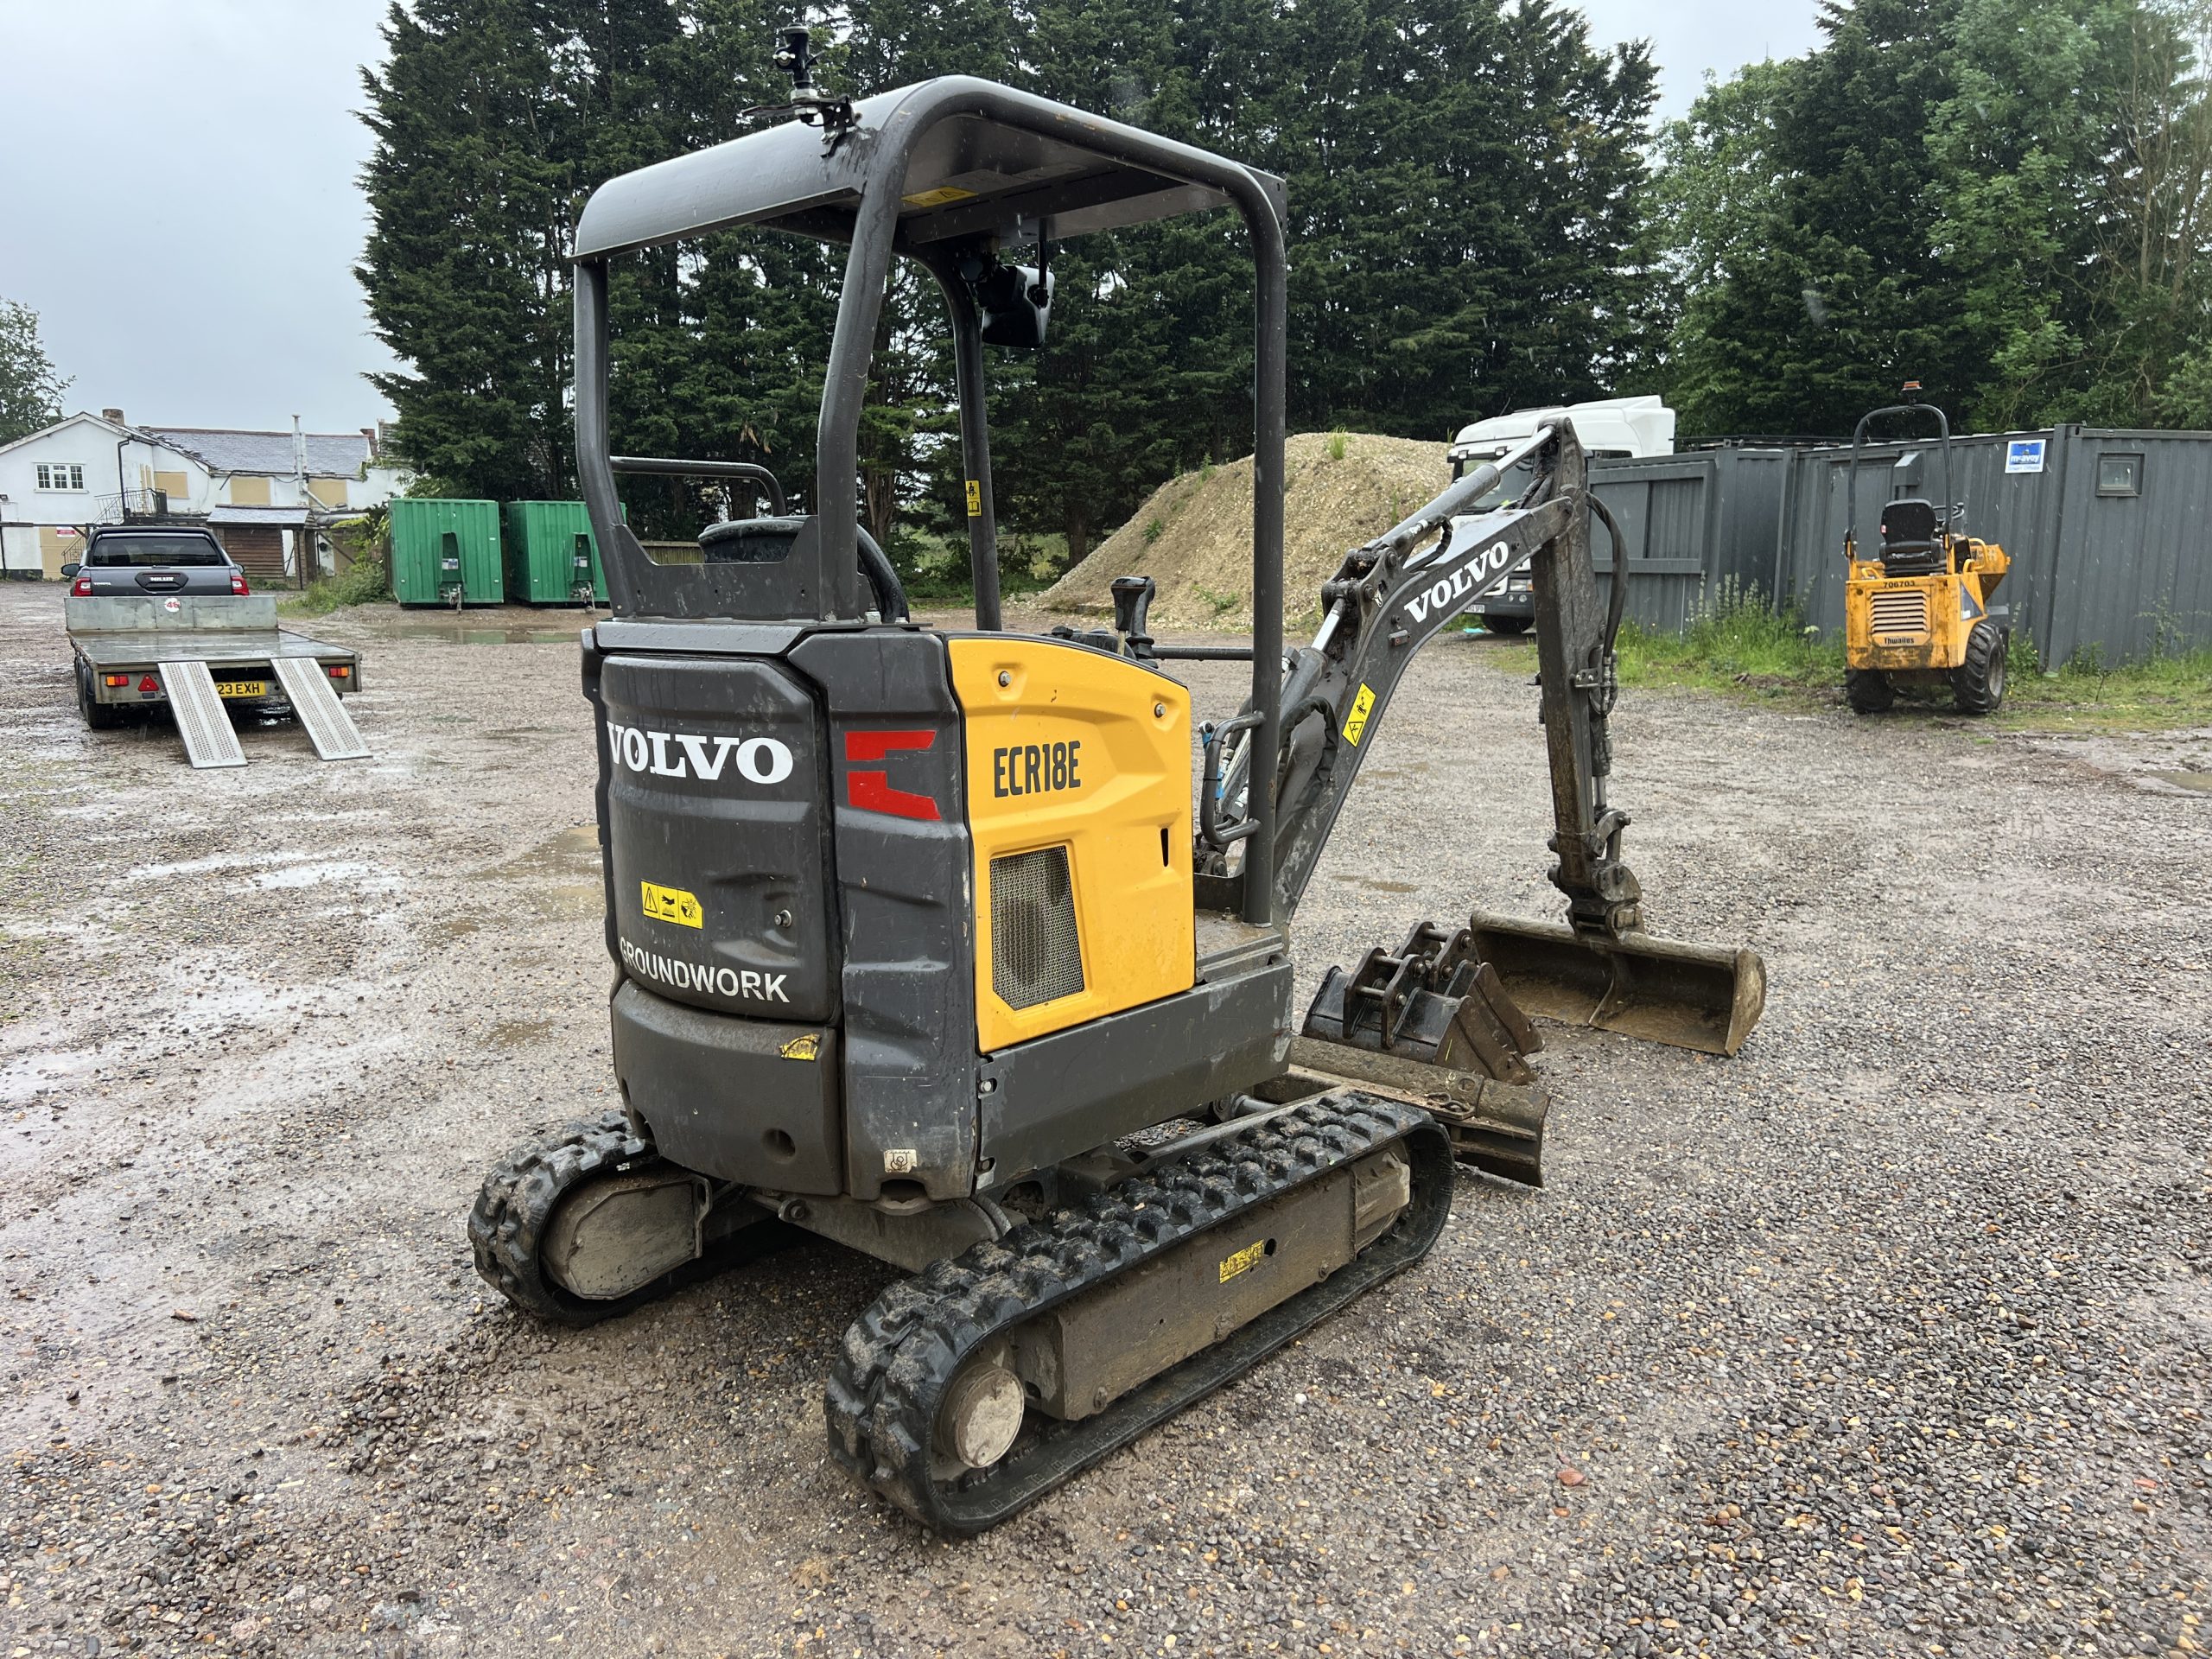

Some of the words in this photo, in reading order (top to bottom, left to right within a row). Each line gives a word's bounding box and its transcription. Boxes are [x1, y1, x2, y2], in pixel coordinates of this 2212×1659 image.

[1404, 541, 1509, 623] VOLVO
[236, 683, 260, 695] EXH
[607, 721, 793, 784] VOLVO
[995, 741, 1081, 798] ECR18E
[620, 937, 791, 1003] GROUNDWORK
